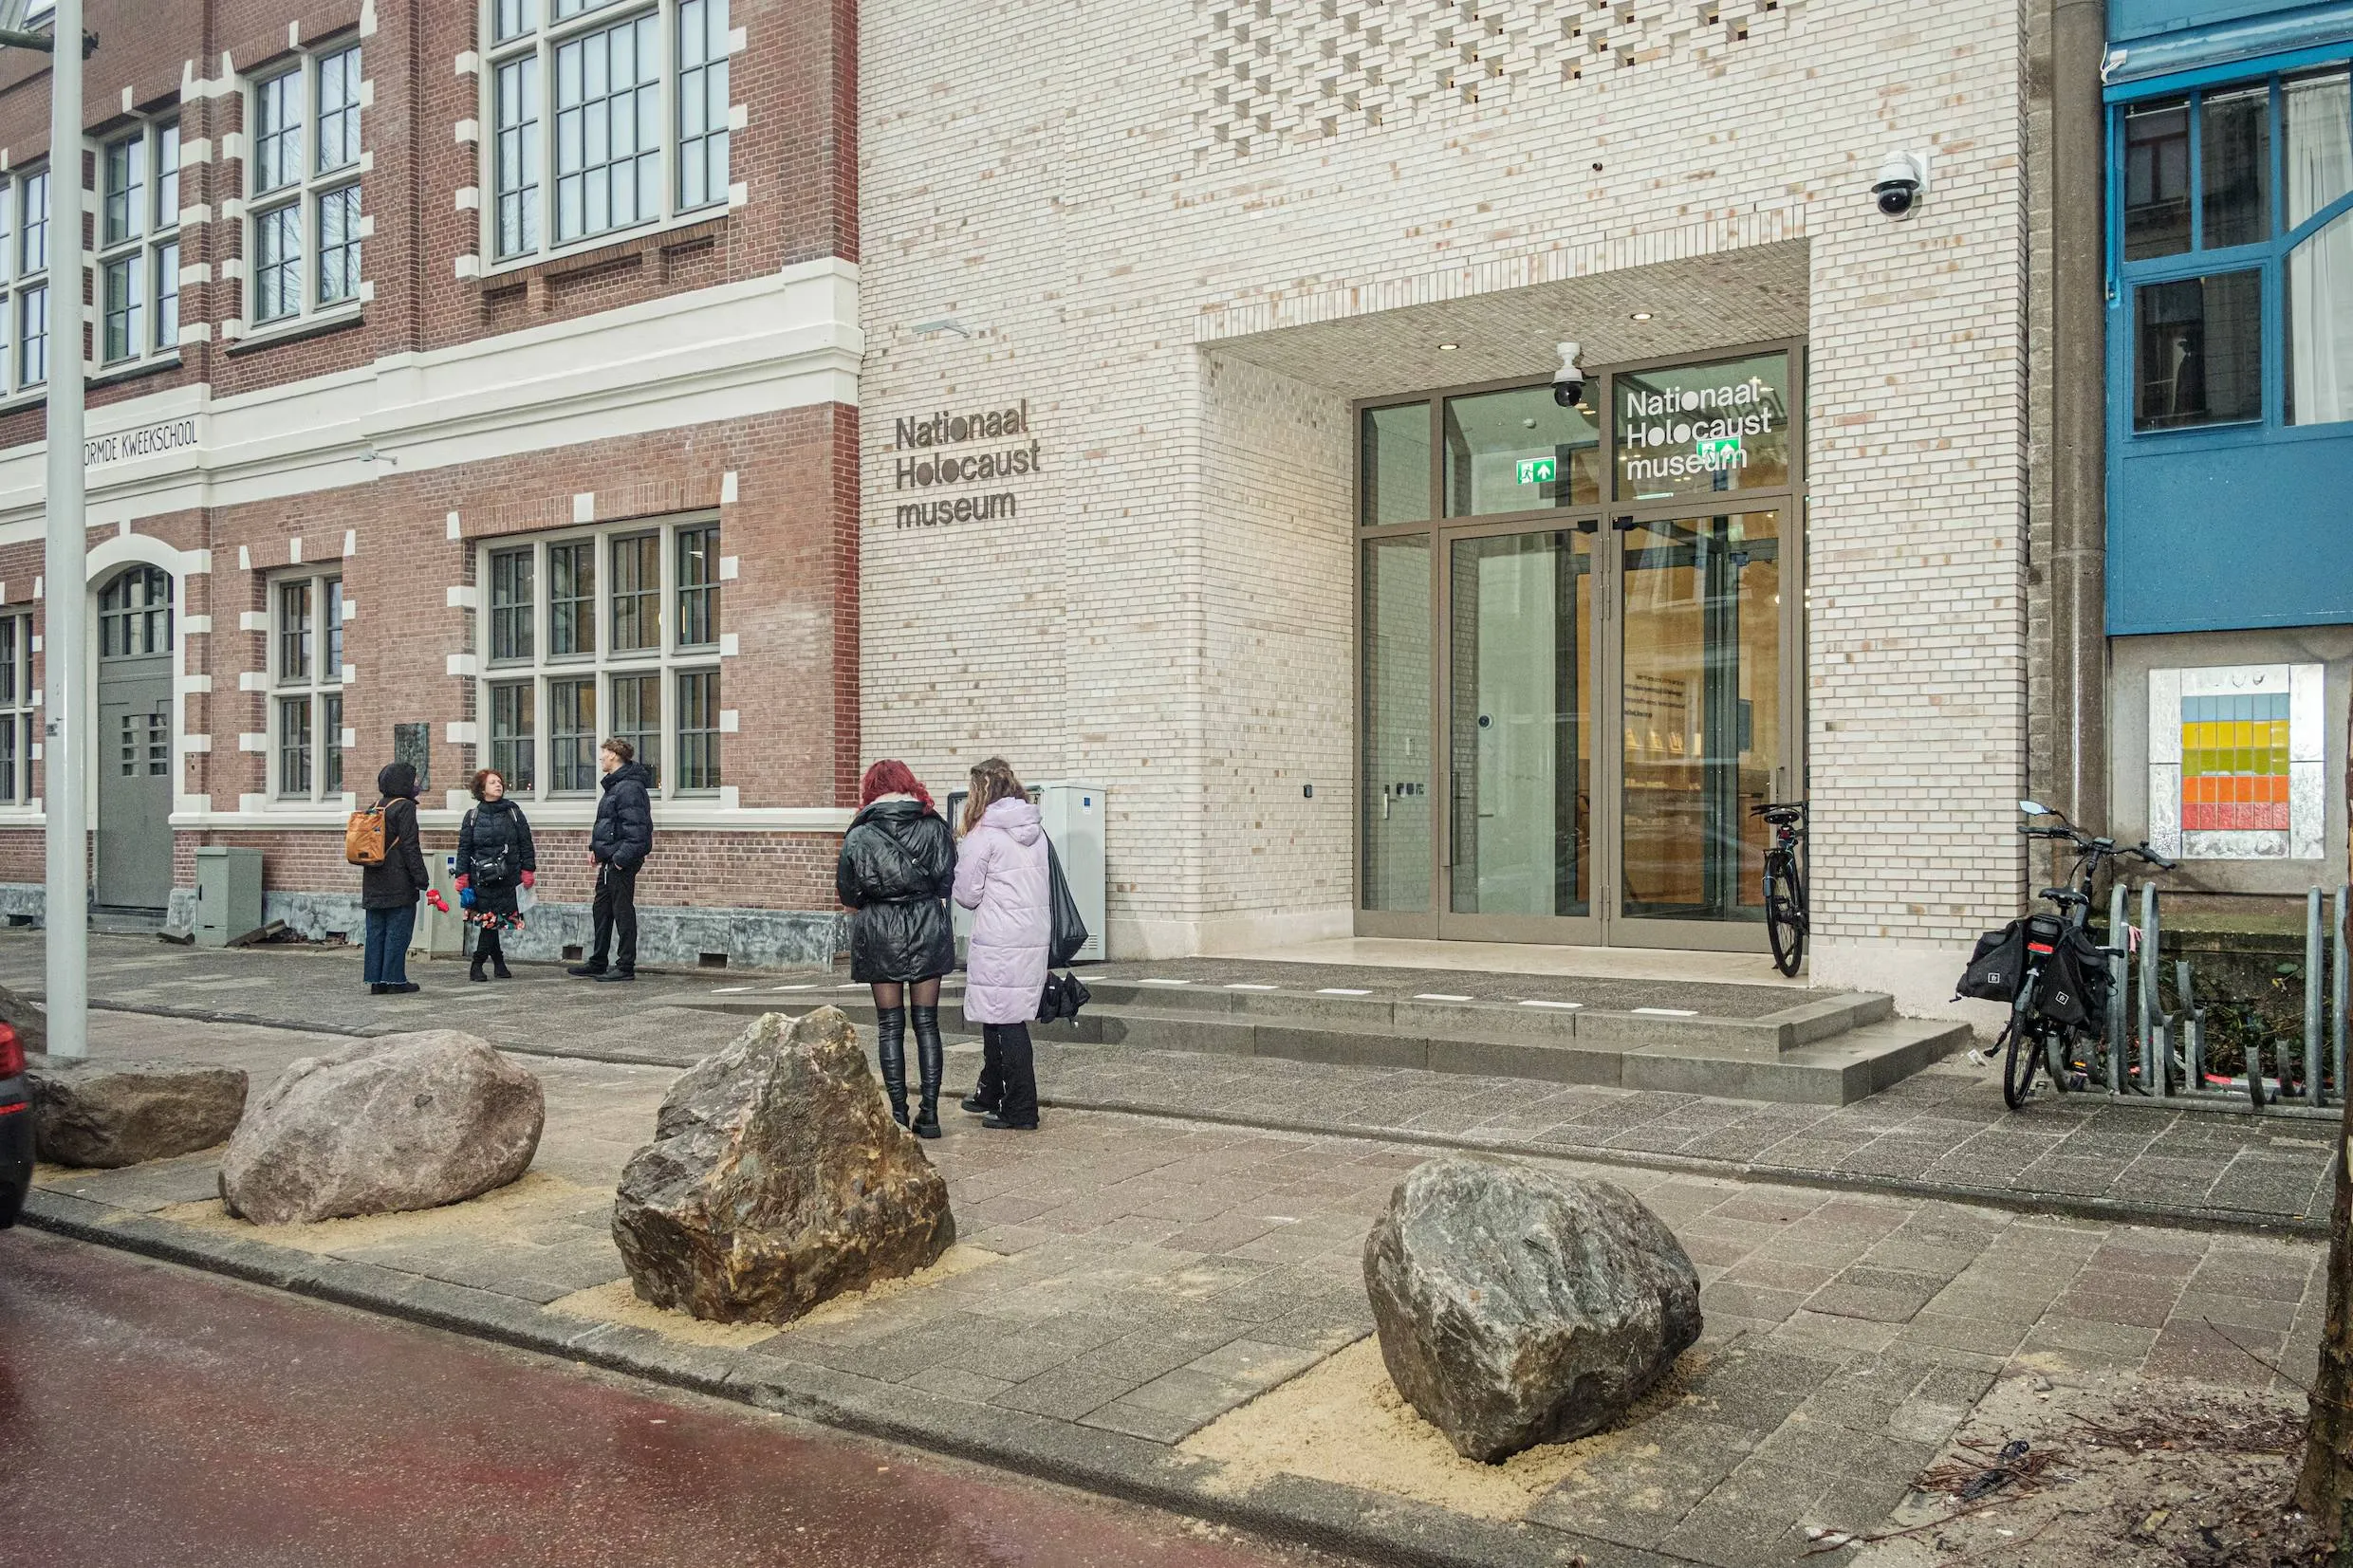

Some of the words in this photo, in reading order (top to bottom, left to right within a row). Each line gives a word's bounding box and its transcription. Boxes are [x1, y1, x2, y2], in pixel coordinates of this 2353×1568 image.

[1627, 378, 1760, 418] Nationaal
[83, 437, 117, 466] ORMDE
[121, 420, 197, 458] KWEEKSCHOOL
[896, 398, 1028, 450] Nationaal
[1627, 407, 1772, 450] Holocaust
[896, 439, 1041, 489] Holocaust
[1627, 447, 1748, 481] museum
[897, 491, 1016, 529] museum
